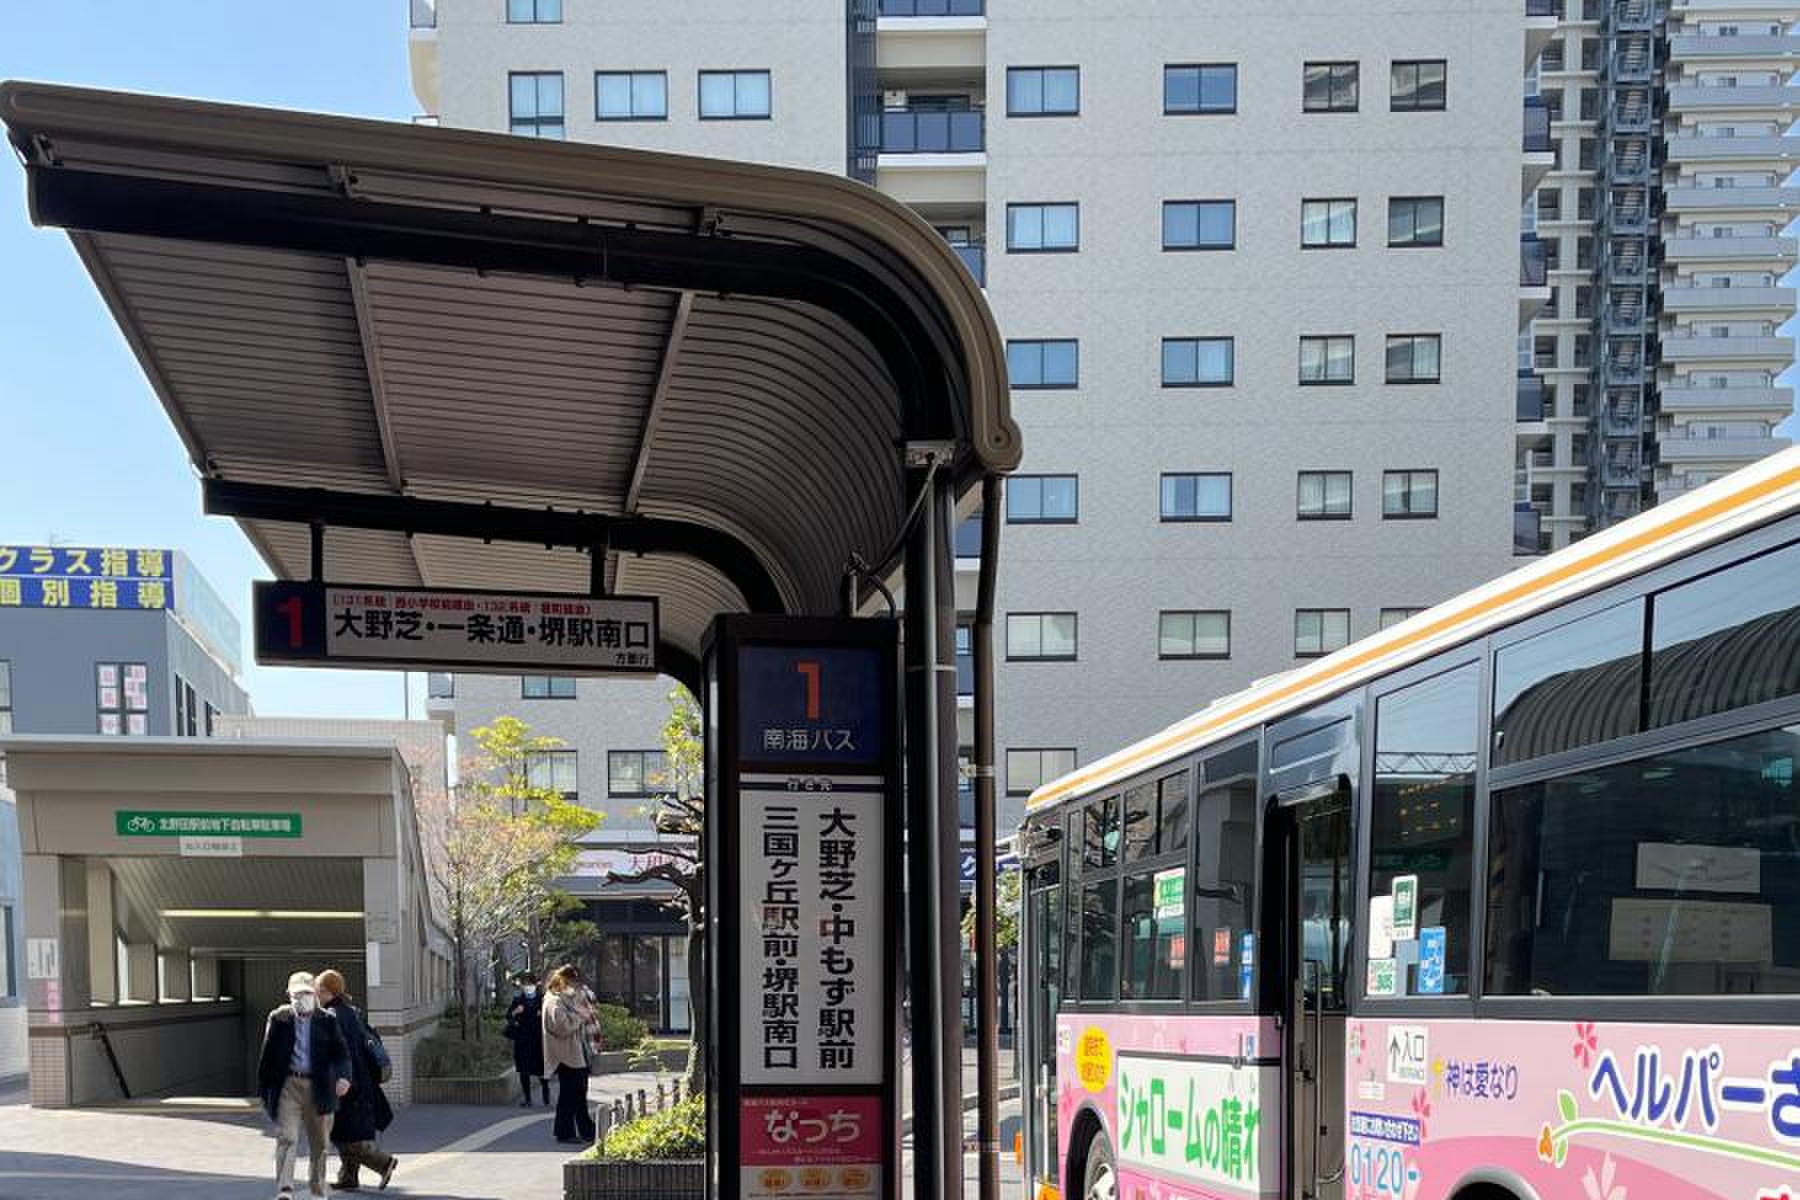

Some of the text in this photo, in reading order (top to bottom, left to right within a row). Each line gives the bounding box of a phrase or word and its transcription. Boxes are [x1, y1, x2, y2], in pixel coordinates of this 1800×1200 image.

[278, 596, 304, 648] 1
[334, 608, 650, 649] 大野芝・一条通・堺駅南口
[797, 661, 822, 720] 1
[763, 728, 856, 752] 南海バス
[818, 807, 856, 1070] 大野芝・中もず駅前
[1402, 1031, 1425, 1062] 入口
[1446, 1058, 1519, 1101] 神は愛なり
